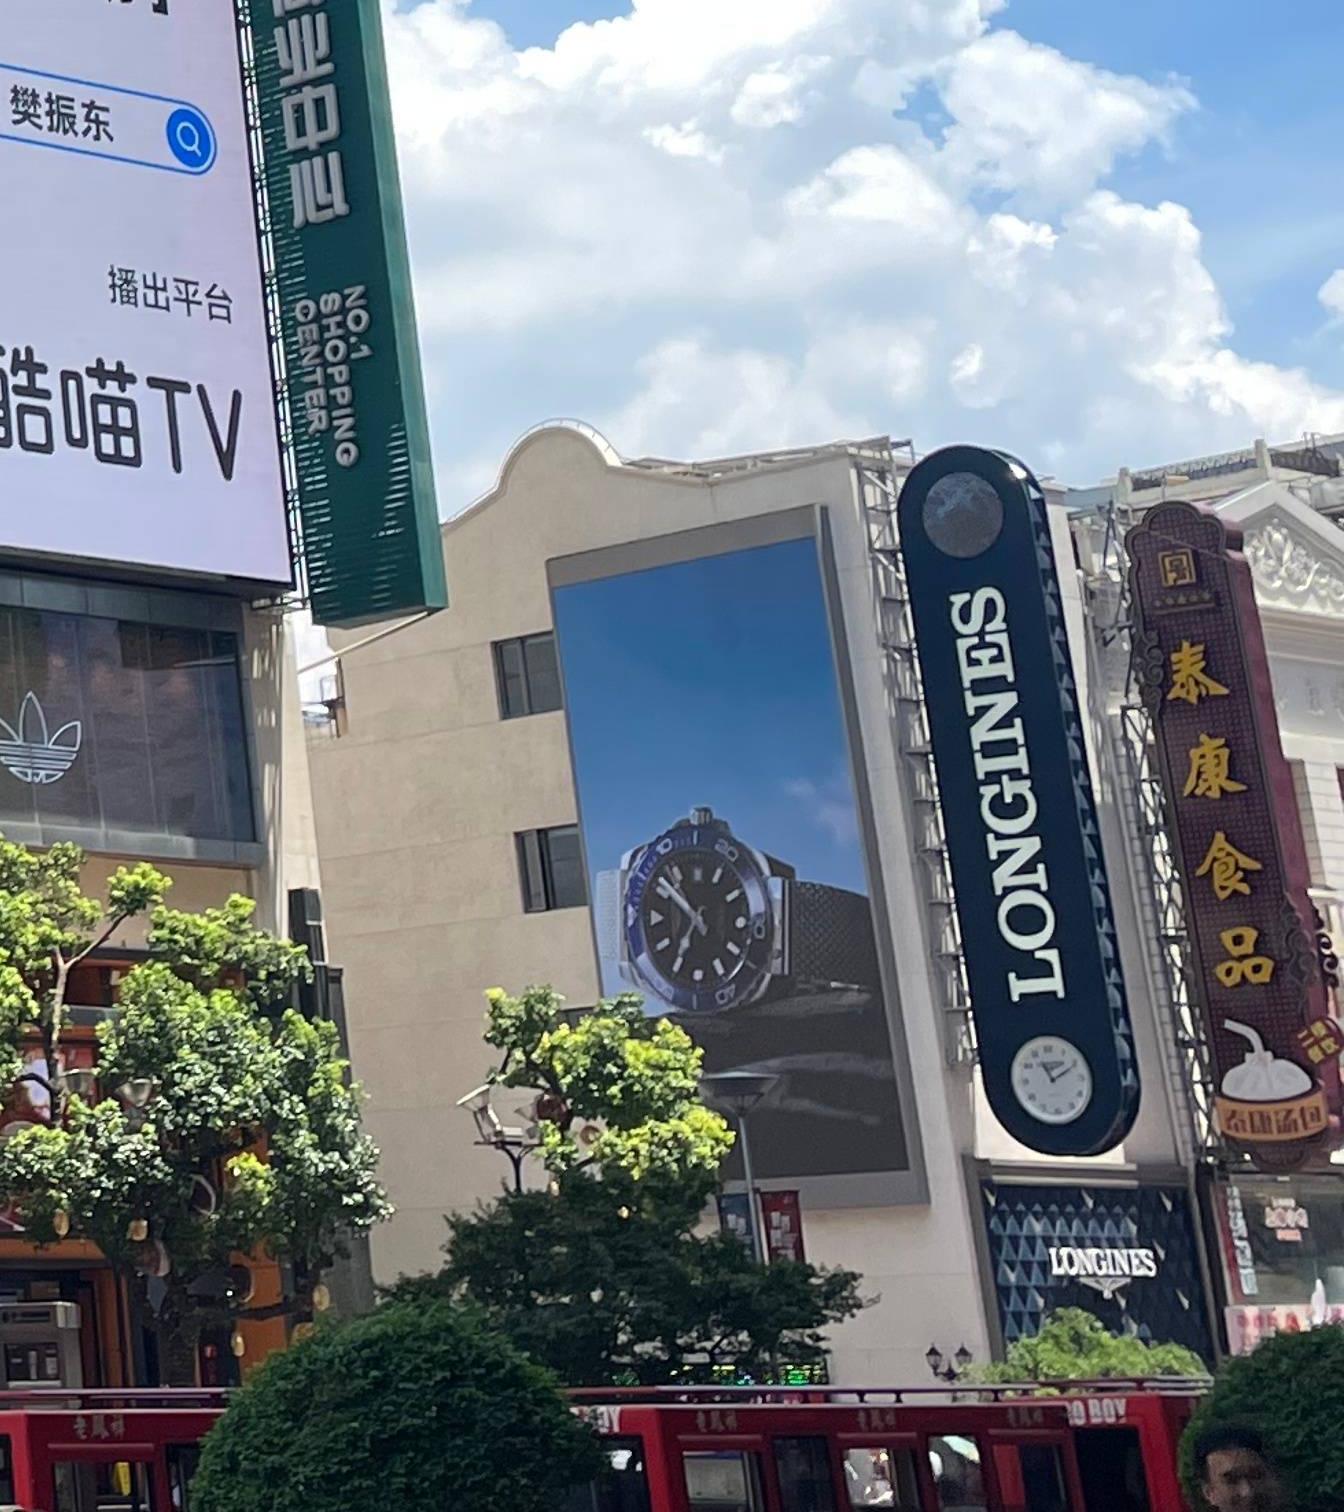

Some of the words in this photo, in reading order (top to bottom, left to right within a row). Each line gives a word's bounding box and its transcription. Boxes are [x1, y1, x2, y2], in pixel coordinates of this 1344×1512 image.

[10, 85, 114, 143] 樊振东
[108, 264, 233, 324] 播出平台
[295, 298, 329, 435] CENTER
[319, 292, 359, 467] SHOPPING
[949, 586, 1065, 1002] LONGINES
[1167, 640, 1274, 987] 泰康食品
[1049, 1247, 1157, 1278] LONGINES
